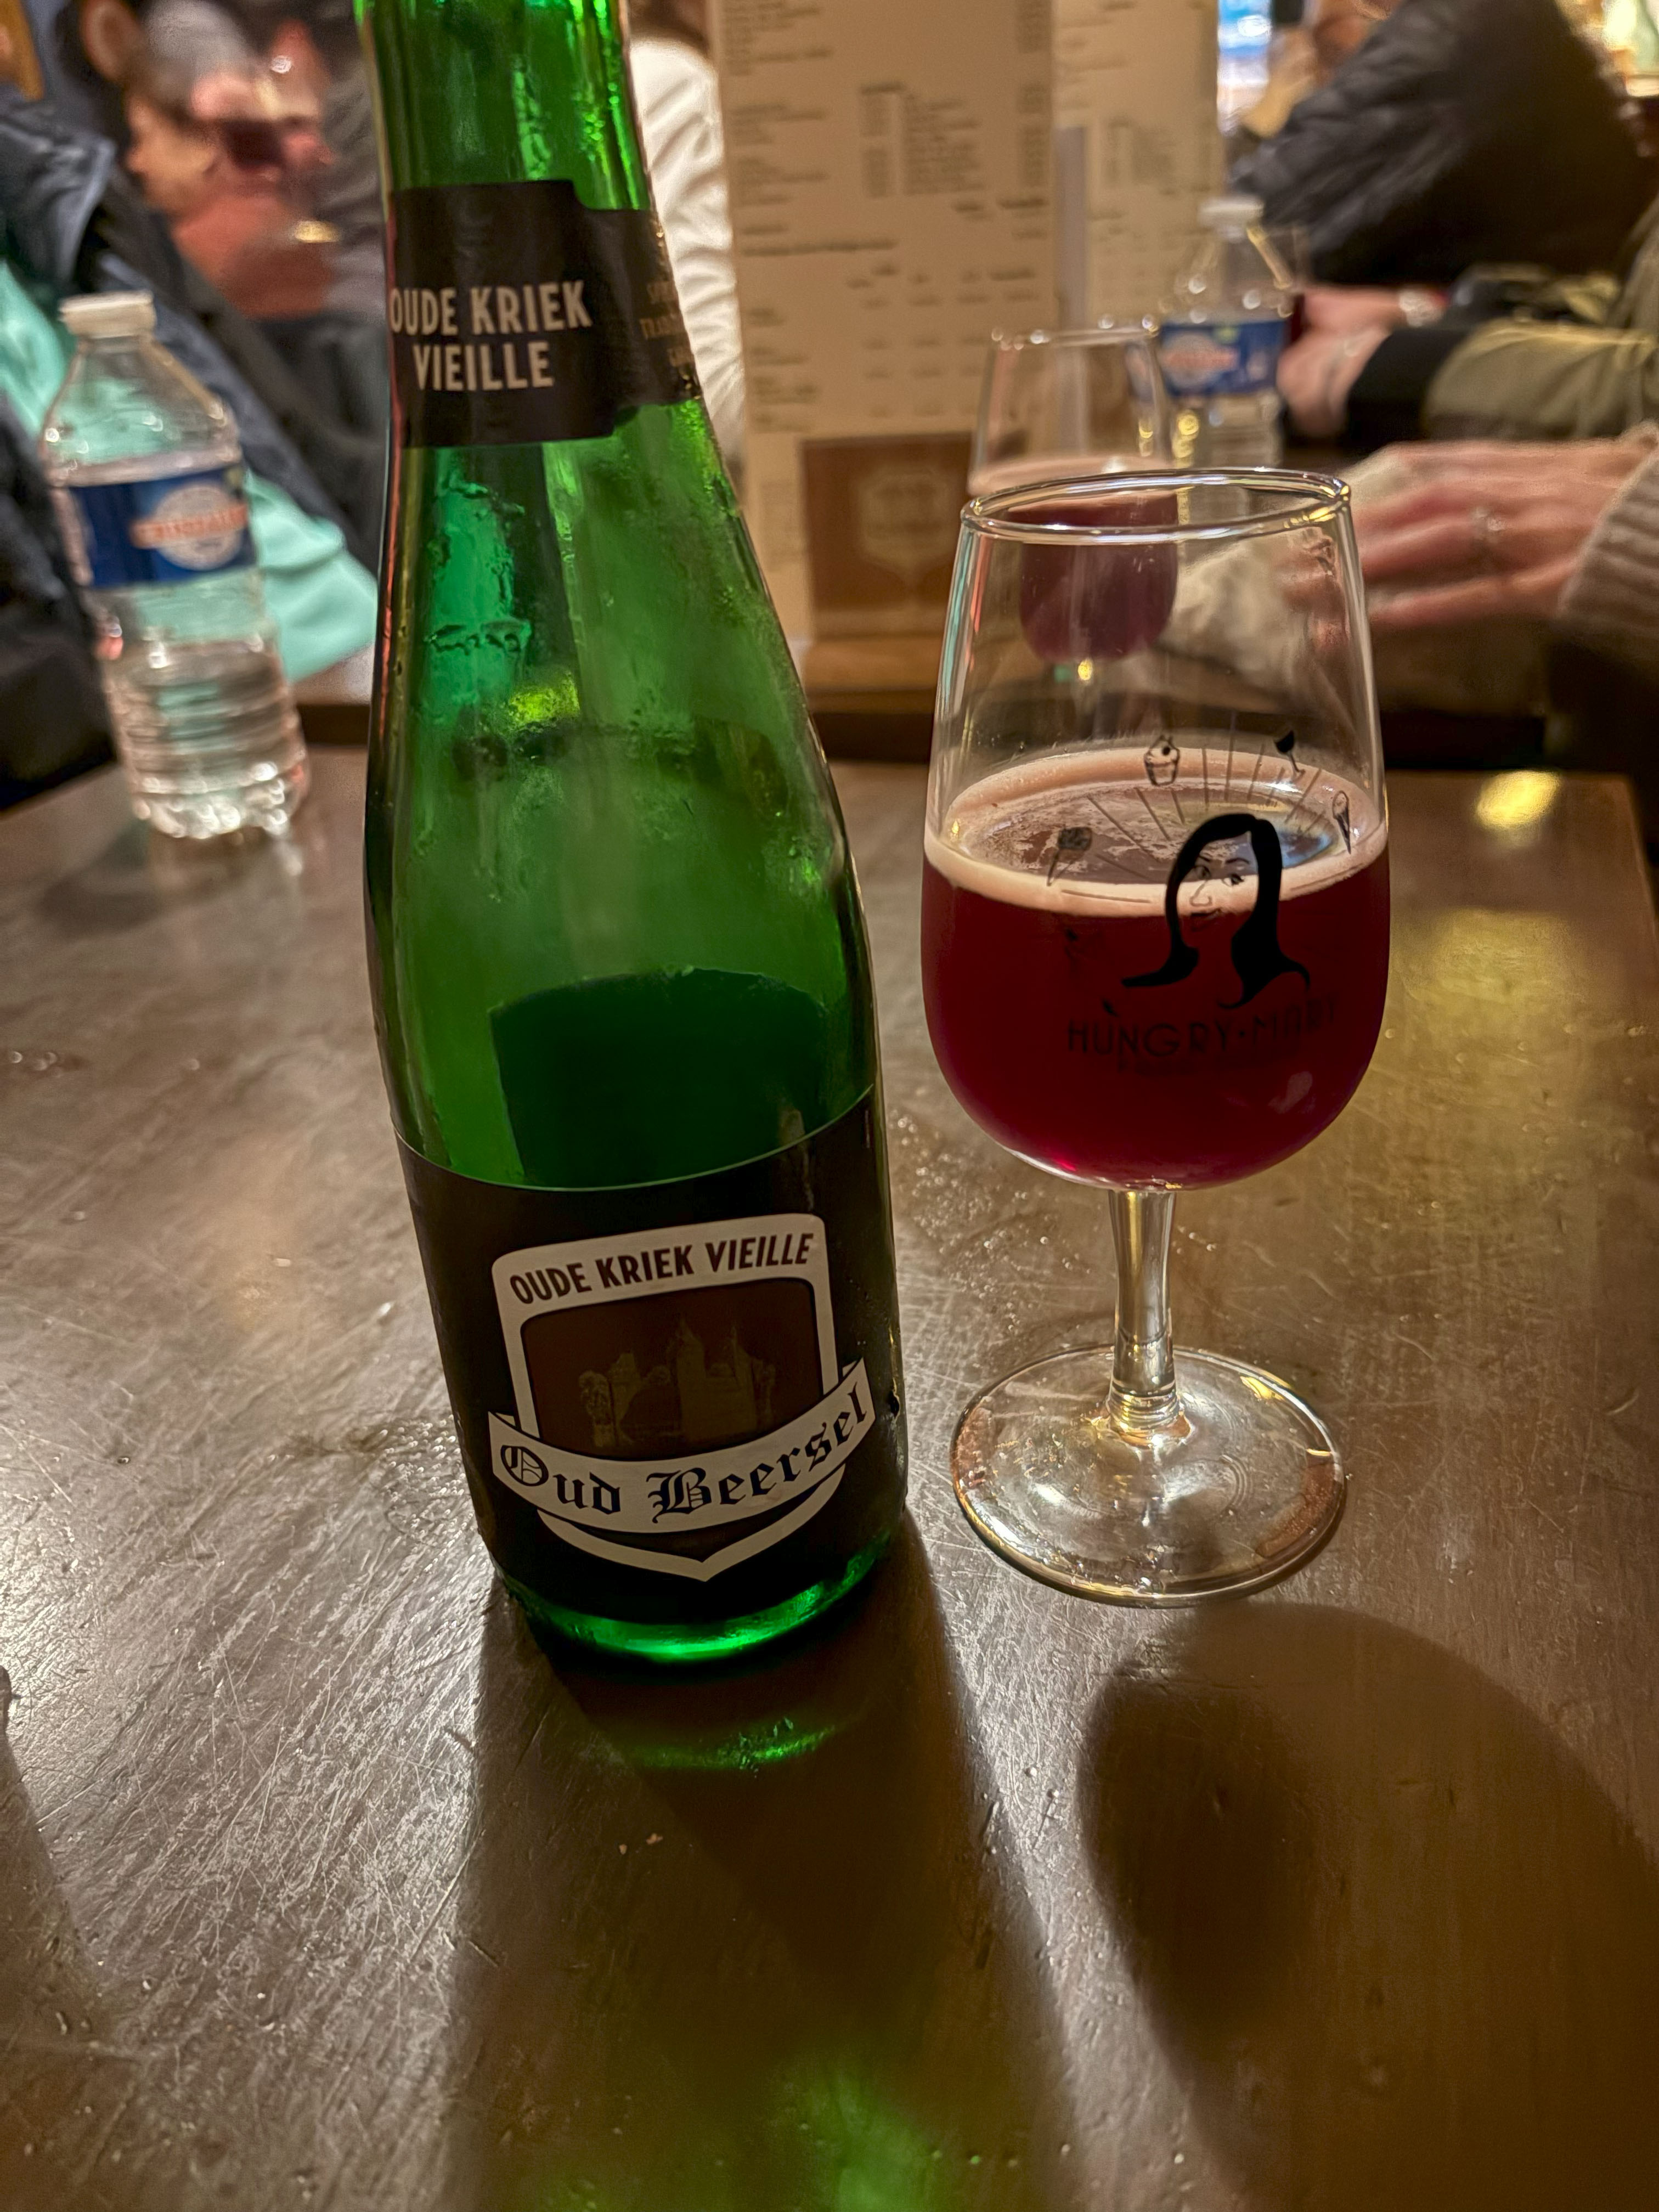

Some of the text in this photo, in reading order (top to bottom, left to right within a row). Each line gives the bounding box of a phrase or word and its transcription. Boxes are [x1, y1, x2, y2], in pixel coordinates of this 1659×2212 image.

[390, 289, 456, 335] OUDE
[472, 281, 592, 335] KRIEK
[413, 341, 554, 391] VIEILLE
[510, 1233, 814, 1304] OUDE KRIEK VIEILLE
[500, 1382, 867, 1523] Oud Beersel
